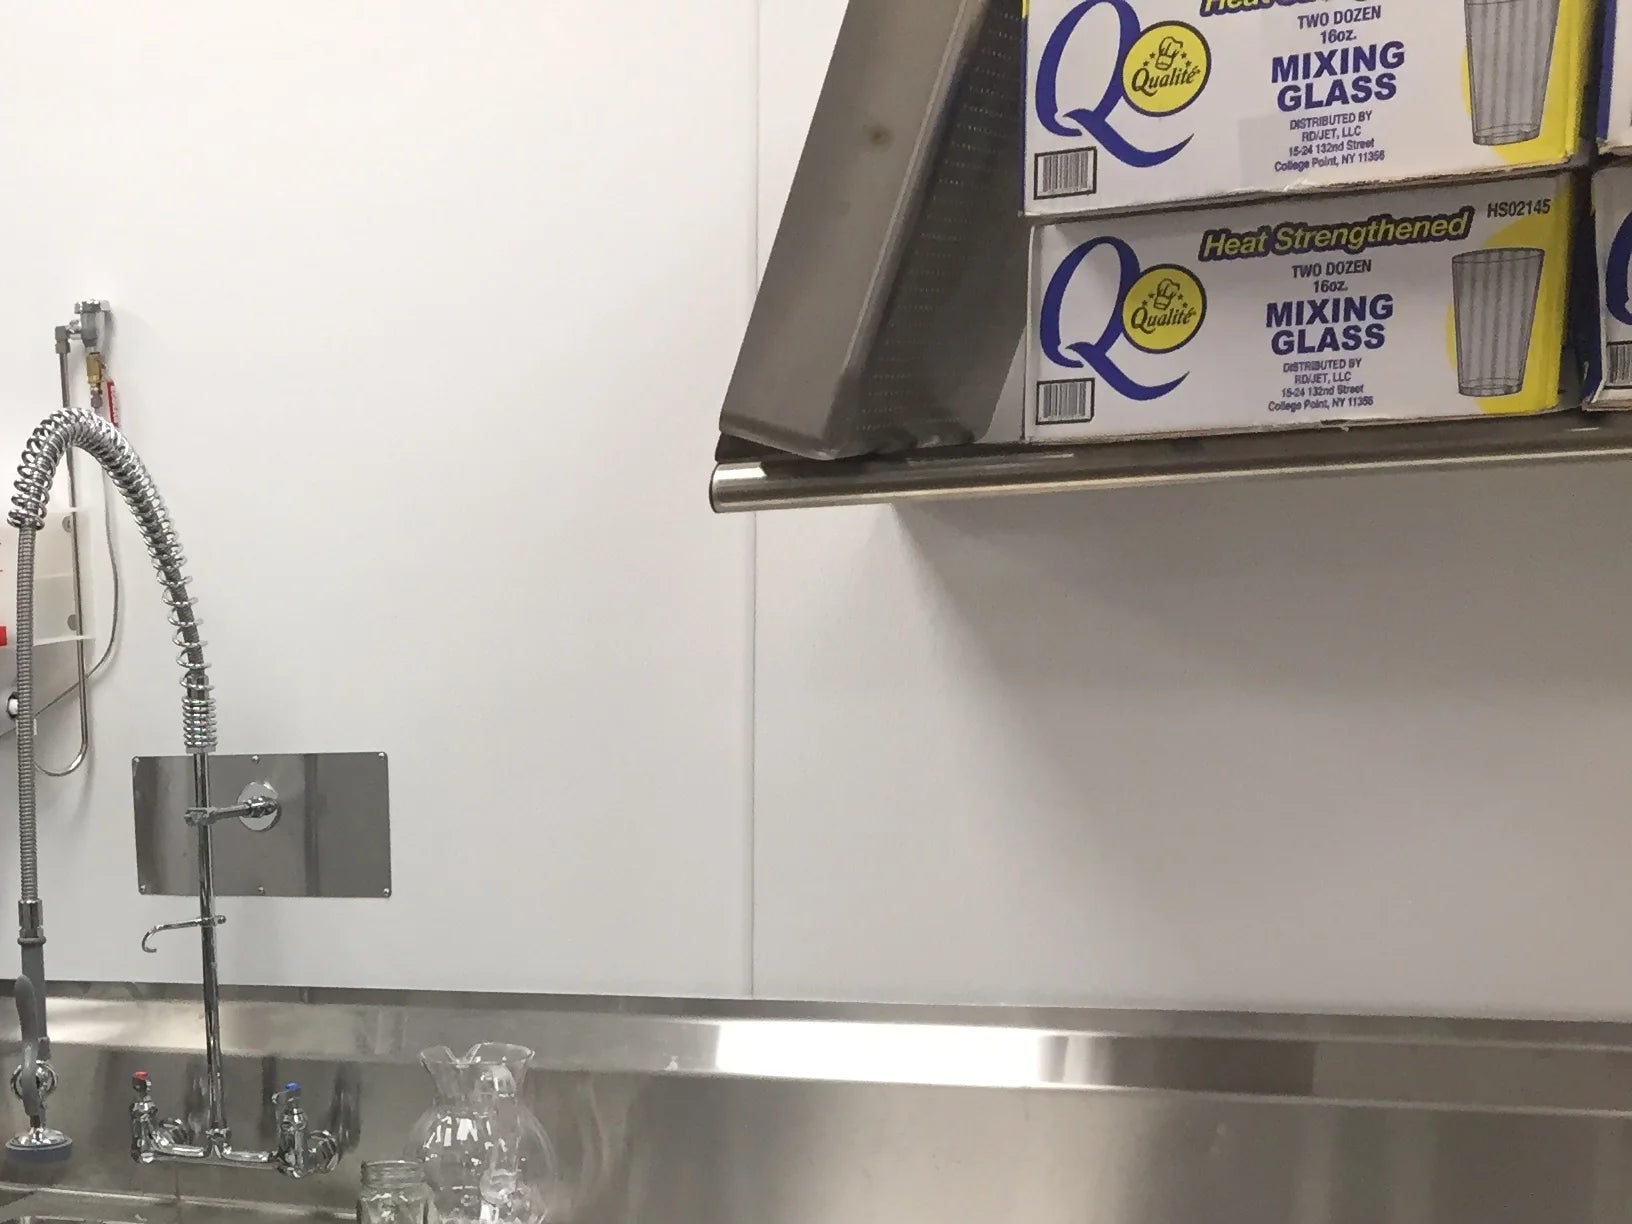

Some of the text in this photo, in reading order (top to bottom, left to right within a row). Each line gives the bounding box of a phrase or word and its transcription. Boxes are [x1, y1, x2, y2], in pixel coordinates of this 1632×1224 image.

[1298, 5, 1381, 29] TWO DOZEN
[1320, 29, 1357, 44] 16oz.
[1272, 41, 1405, 83] MIXING
[1278, 73, 1397, 112] GLASS
[1289, 110, 1373, 130] DISTRIBUTED BY
[1302, 126, 1361, 142] RD/JET, LLC
[1289, 138, 1375, 157] 15-24 132nd Street
[1274, 159, 1309, 172] College
[1312, 155, 1339, 168] Point,
[1342, 153, 1355, 164] NY
[1487, 199, 1551, 218] HS02145
[1202, 210, 1472, 258] Heat Strengthened
[1292, 258, 1372, 279] TWO DOZEN
[1314, 279, 1348, 293] 16oz.
[1266, 293, 1393, 328] MIXING
[1271, 323, 1385, 355] GLASS
[1283, 358, 1362, 373] DISTRIBUTED BY
[1333, 371, 1352, 382] LLC
[1308, 385, 1335, 397] 132nd
[1268, 400, 1302, 412] College
[1332, 397, 1346, 407] NY
